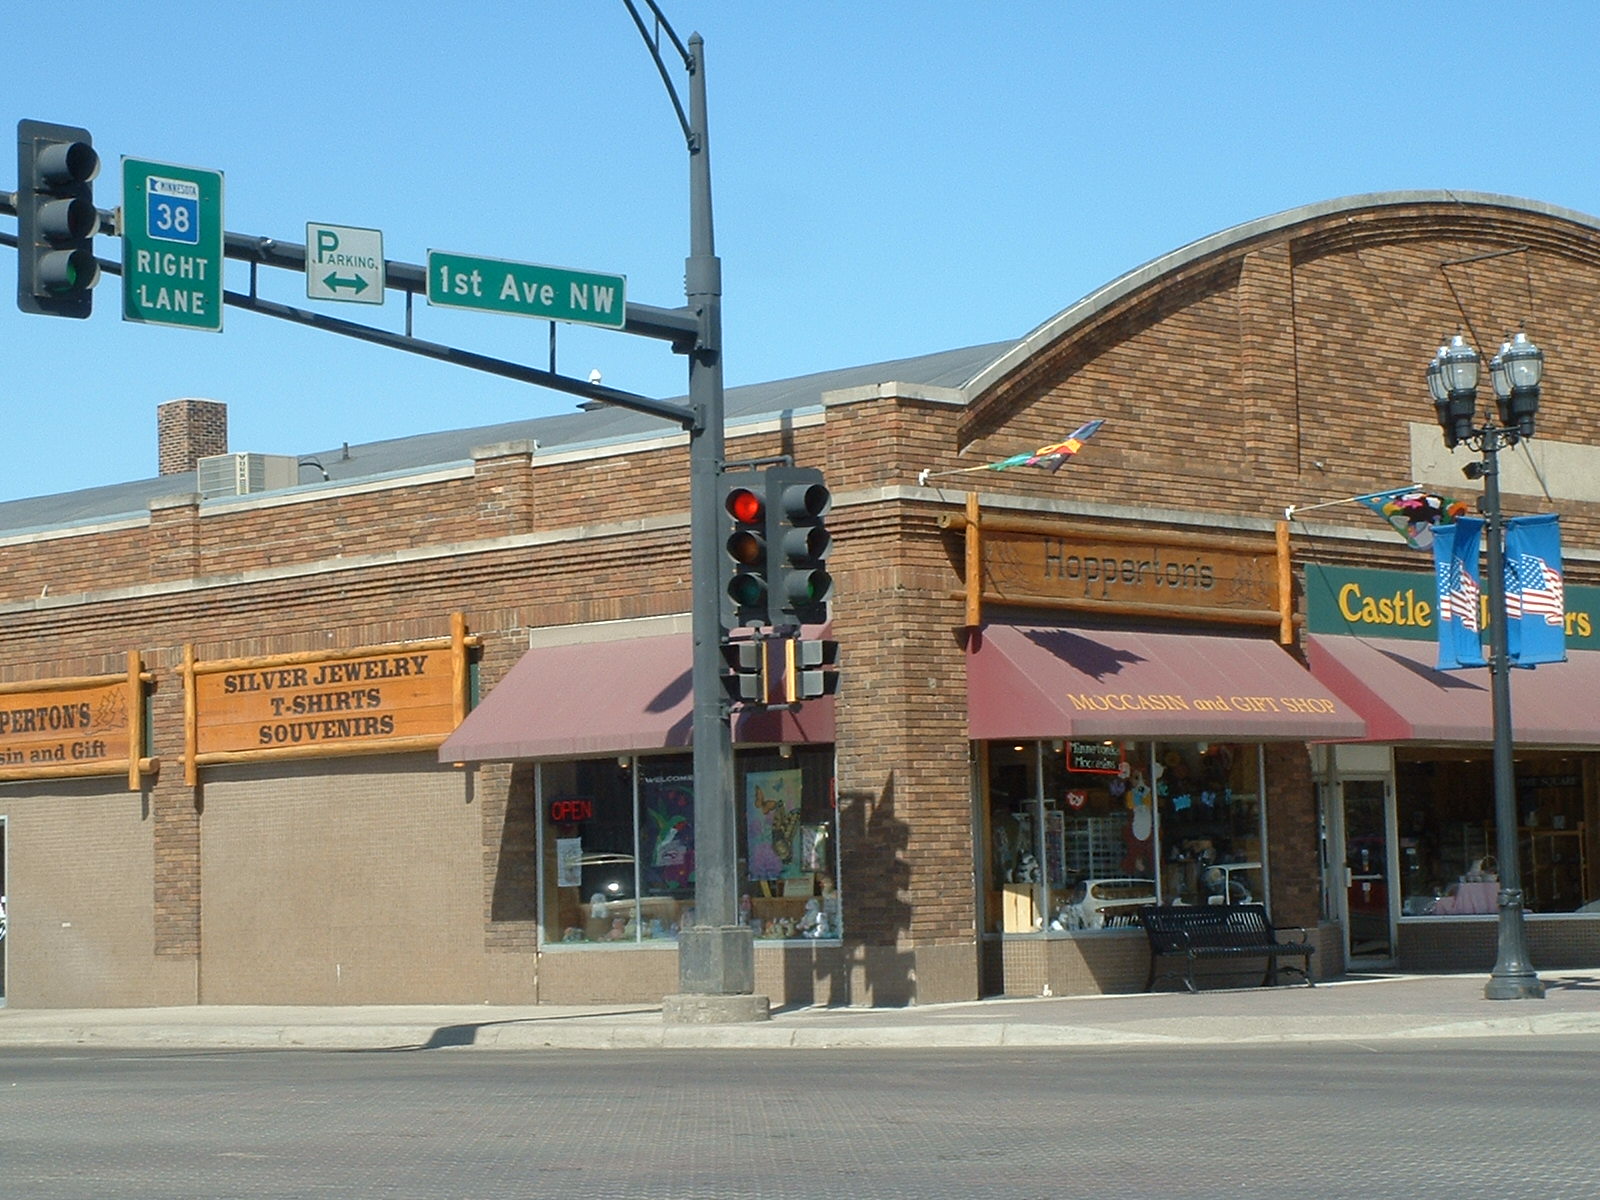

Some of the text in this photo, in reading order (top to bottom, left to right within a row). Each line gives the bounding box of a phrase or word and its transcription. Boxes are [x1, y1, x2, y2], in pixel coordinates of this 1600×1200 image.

[161, 181, 197, 195] MINNESOTA
[156, 203, 190, 233] 38
[137, 249, 208, 280] RIGHT
[317, 229, 375, 270] PARKING
[140, 284, 205, 315] LANE
[440, 265, 614, 314] 1st Ave NW
[1043, 537, 1215, 598] Hopperton's
[1338, 582, 1432, 628] Castle
[223, 655, 428, 695] SILVER JEWELRY
[270, 688, 381, 717] T-SHIRTS
[1065, 693, 1336, 714] MOCCASIN and GIFT SHOP
[258, 715, 394, 745] SOUVENIRS
[30, 743, 66, 763] and
[71, 740, 106, 760] Gift
[551, 800, 593, 820] OPEN
